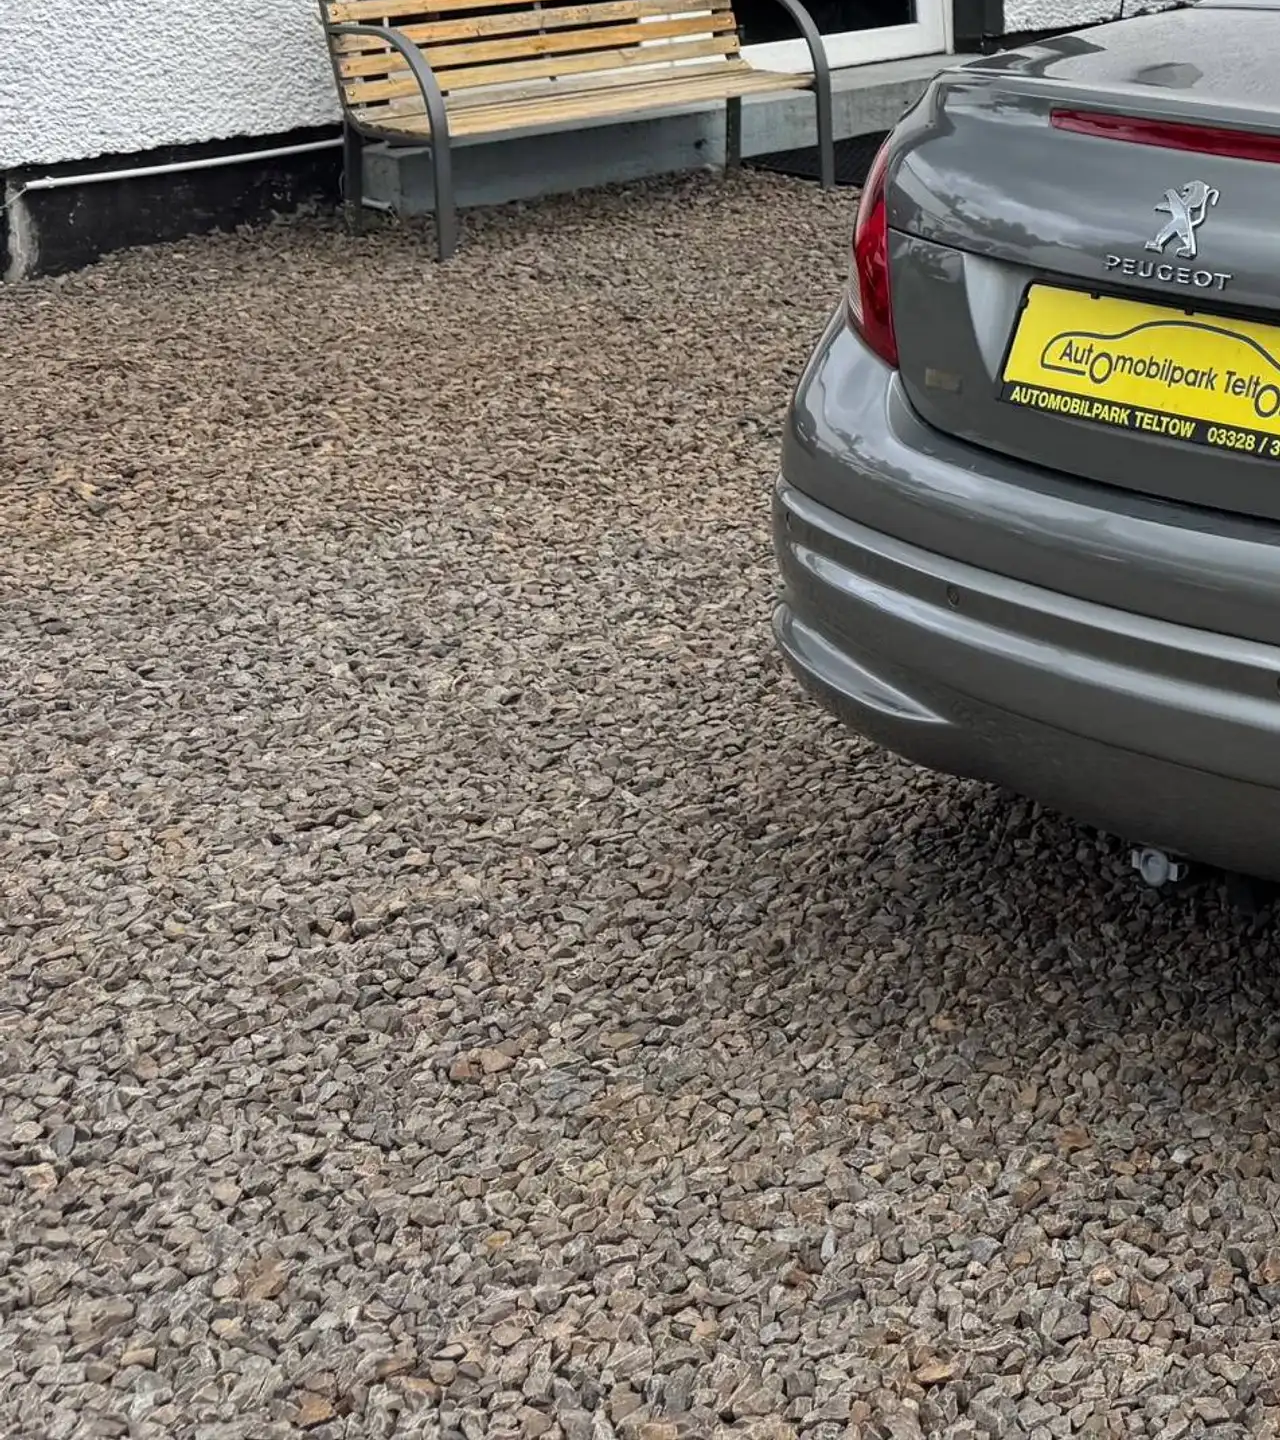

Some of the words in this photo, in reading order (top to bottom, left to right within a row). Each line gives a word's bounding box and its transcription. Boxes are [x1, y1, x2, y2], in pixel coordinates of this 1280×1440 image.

[1103, 253, 1232, 291] PEUGEOT
[1059, 338, 1218, 393] Automobilpark
[1010, 385, 1131, 426] AUTOMOBILPARK
[1133, 411, 1196, 439] TELTOW
[1207, 426, 1256, 452] 03328
[1258, 436, 1267, 453] /
